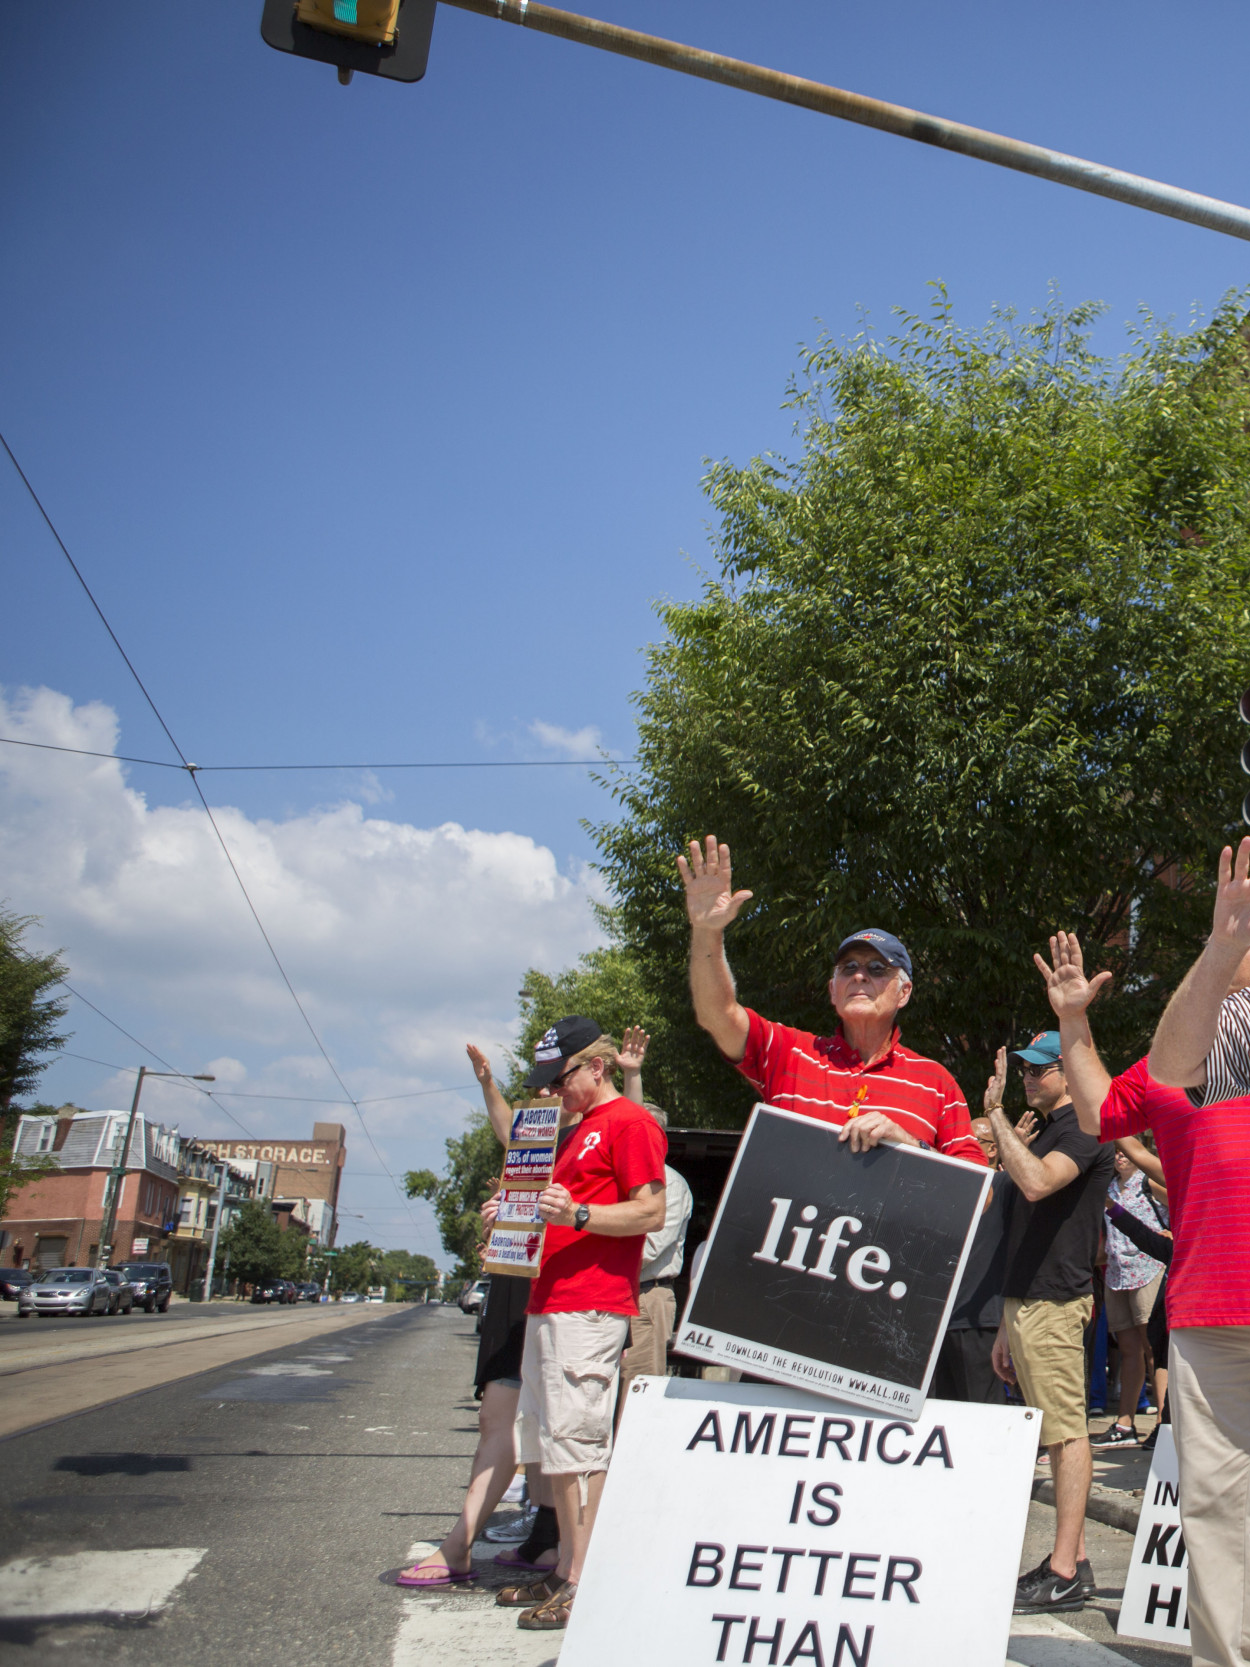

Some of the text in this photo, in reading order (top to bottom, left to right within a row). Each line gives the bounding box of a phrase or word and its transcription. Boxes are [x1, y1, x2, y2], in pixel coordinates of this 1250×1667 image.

[525, 1109, 558, 1125] ABORTION
[538, 1126, 556, 1137] WOMEN
[234, 1145, 330, 1165] STORAGE.
[505, 1165, 521, 1176] regret
[521, 1165, 532, 1174] their
[507, 1151, 553, 1164] 93% of women
[751, 1197, 908, 1300] life.
[684, 1330, 714, 1349] ALL
[725, 1341, 768, 1362] DOWNLOAD
[772, 1356, 788, 1369] THE
[791, 1362, 844, 1384] REVOLUTION
[848, 1377, 911, 1404] WWW.ALL.ORG
[685, 1409, 954, 1469] AMERICA
[788, 1480, 844, 1527] IS
[685, 1541, 923, 1604] BETTER
[711, 1612, 875, 1667] THAN
